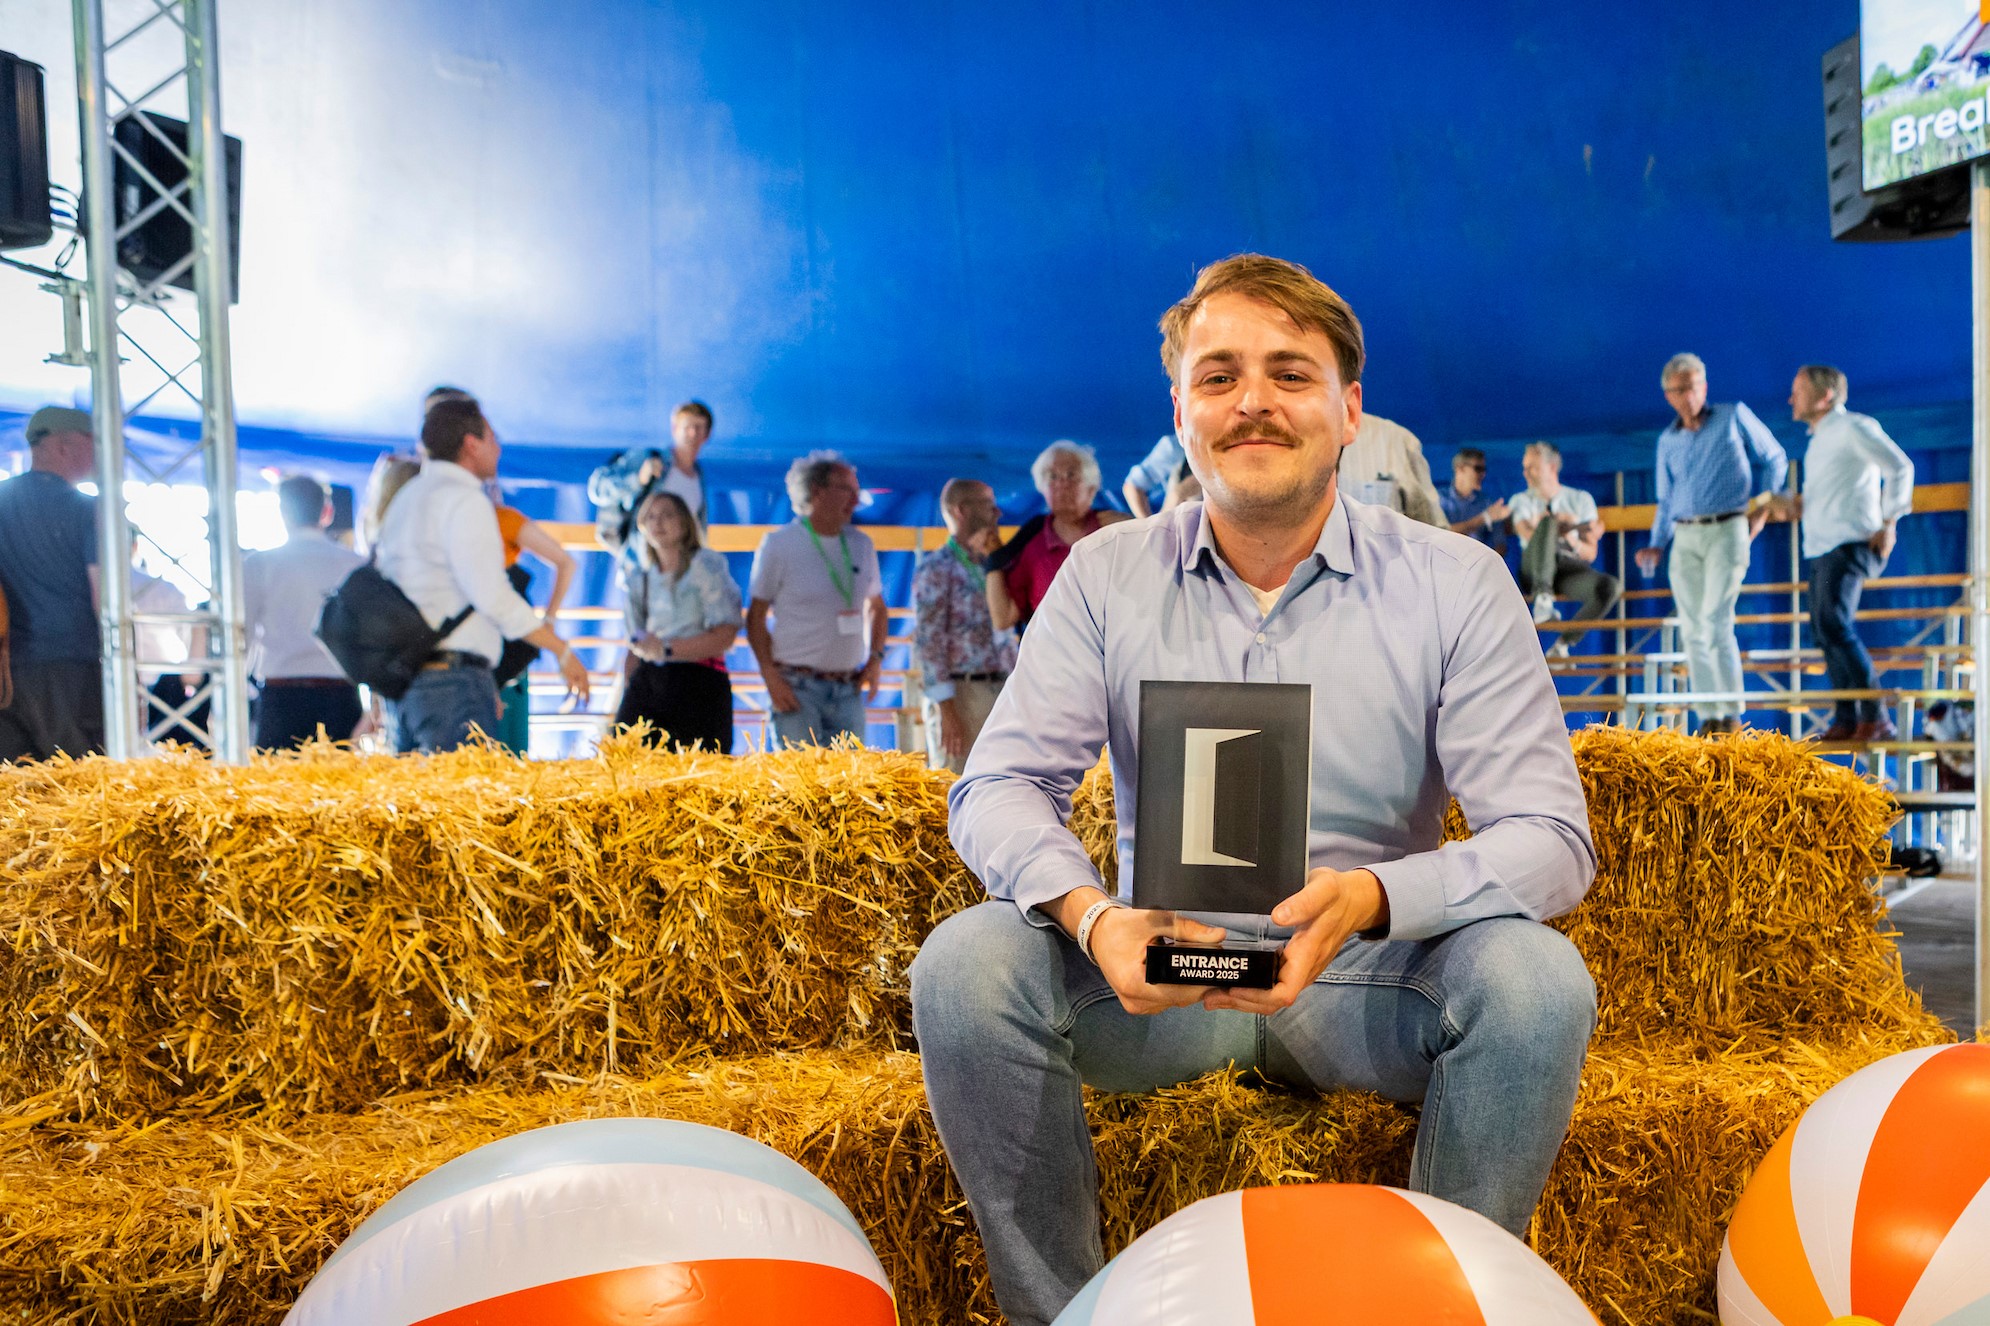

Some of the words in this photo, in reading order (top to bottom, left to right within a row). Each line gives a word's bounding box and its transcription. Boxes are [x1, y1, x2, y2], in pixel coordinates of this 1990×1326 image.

[1171, 954, 1249, 970] ENTRANCE
[1179, 969, 1215, 979] AWARD
[1216, 970, 1240, 980] 2025
